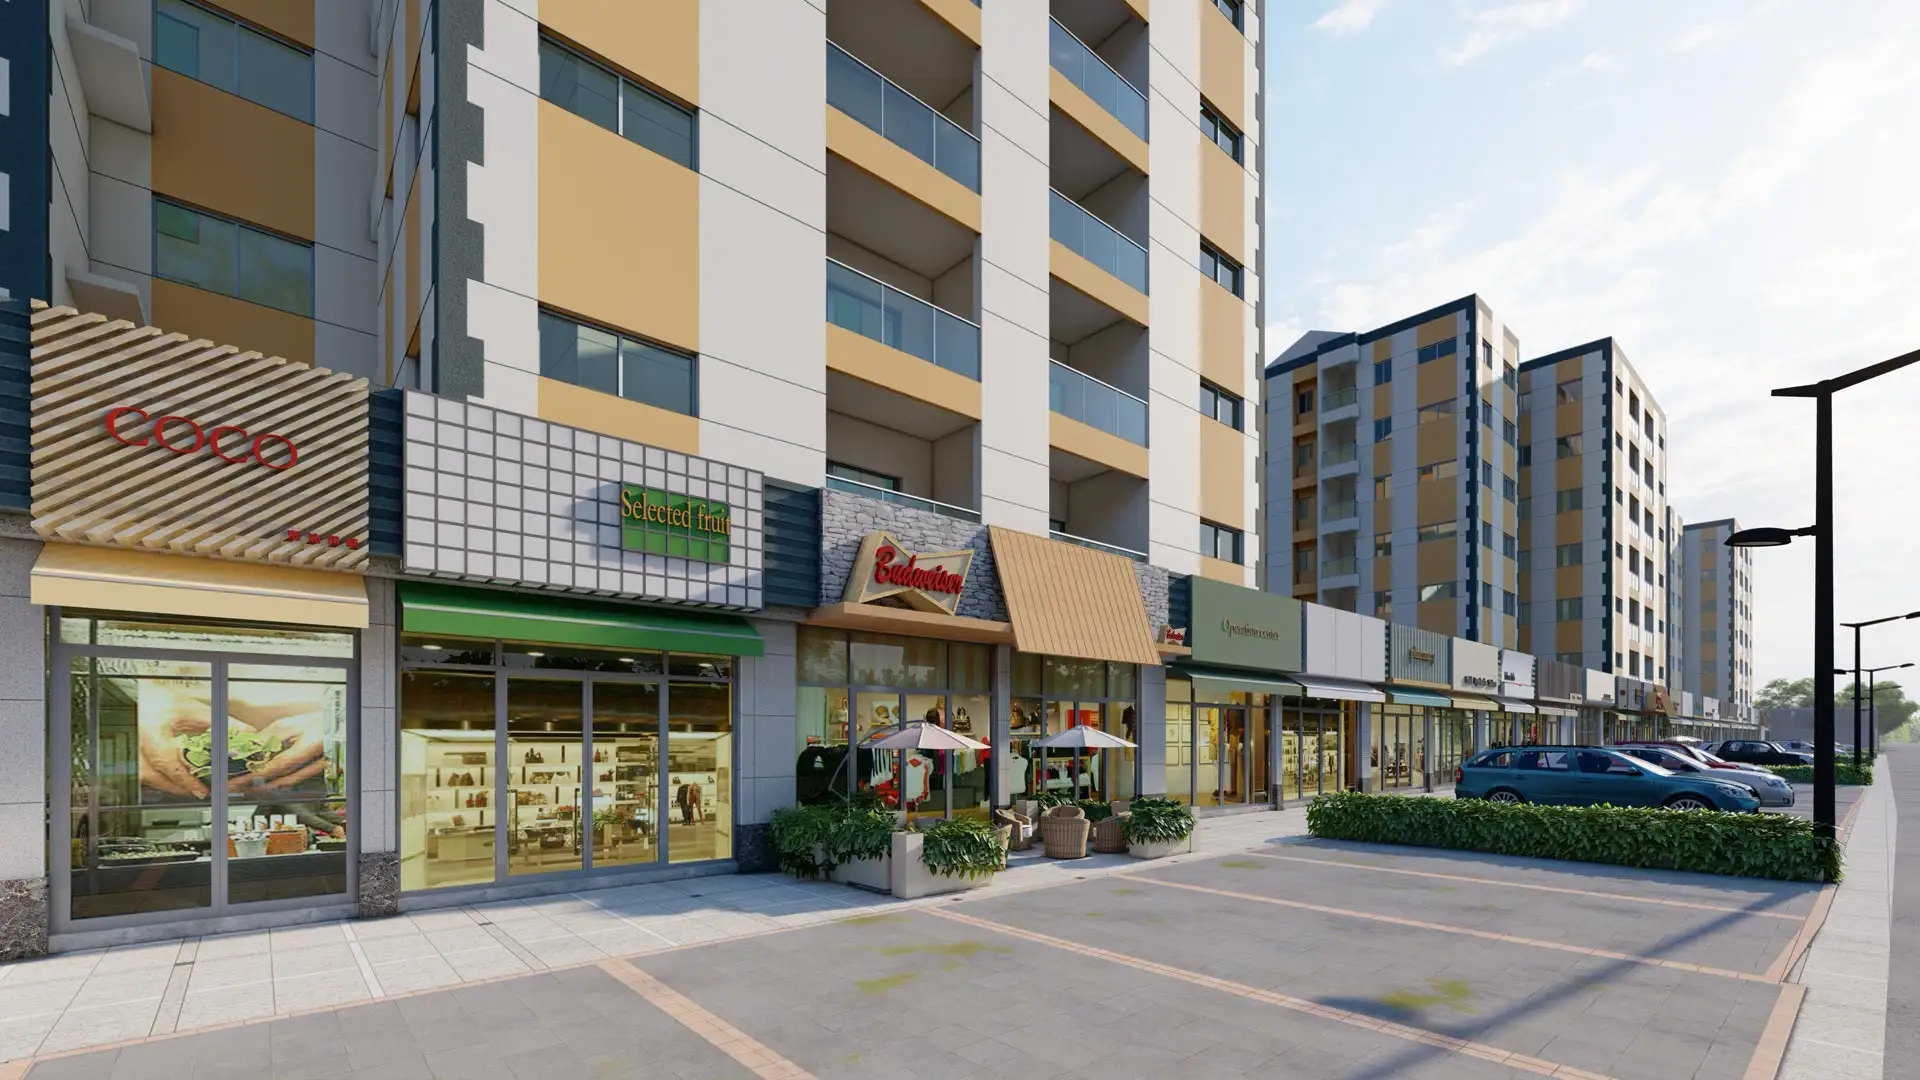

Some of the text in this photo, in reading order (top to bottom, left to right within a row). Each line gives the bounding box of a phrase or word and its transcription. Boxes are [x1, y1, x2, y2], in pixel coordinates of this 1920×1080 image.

[105, 406, 298, 469] COCO
[621, 488, 732, 535] Selected fruit
[874, 545, 963, 594] Budweiser
